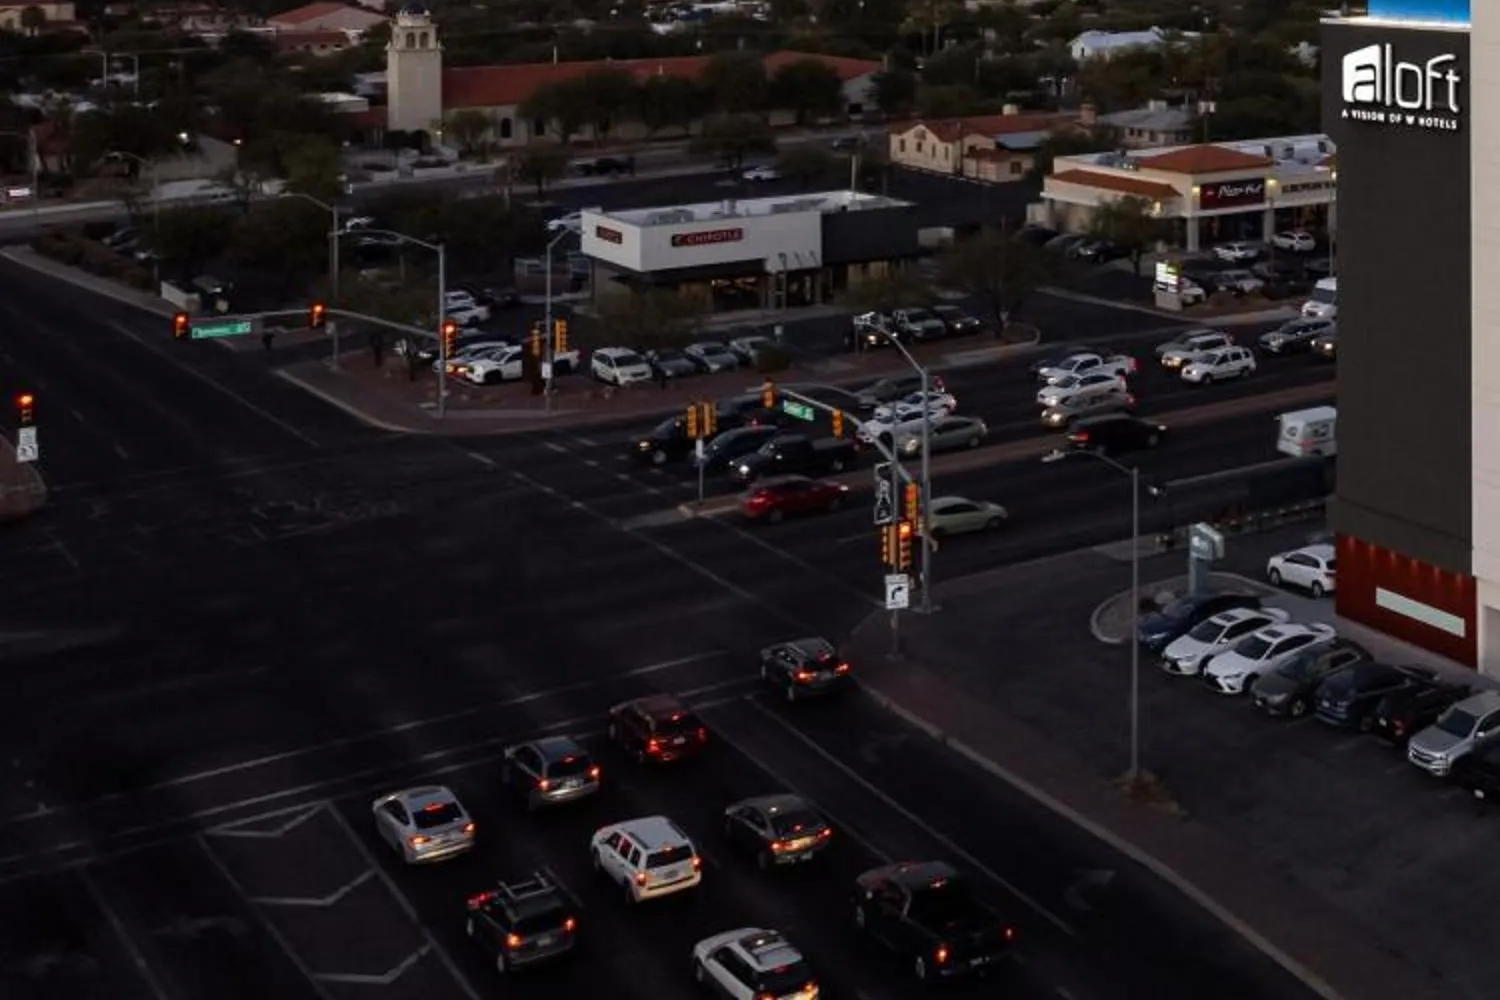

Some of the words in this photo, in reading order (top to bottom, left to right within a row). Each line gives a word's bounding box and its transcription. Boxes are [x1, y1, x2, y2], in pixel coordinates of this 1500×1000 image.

[1342, 43, 1460, 113] aloft
[1341, 108, 1349, 119] A
[1351, 109, 1385, 122] VISION
[1389, 113, 1402, 123] OF
[1405, 115, 1415, 125] W
[1418, 116, 1457, 130] HOTELS
[687, 229, 740, 243] CHIPOTLE
